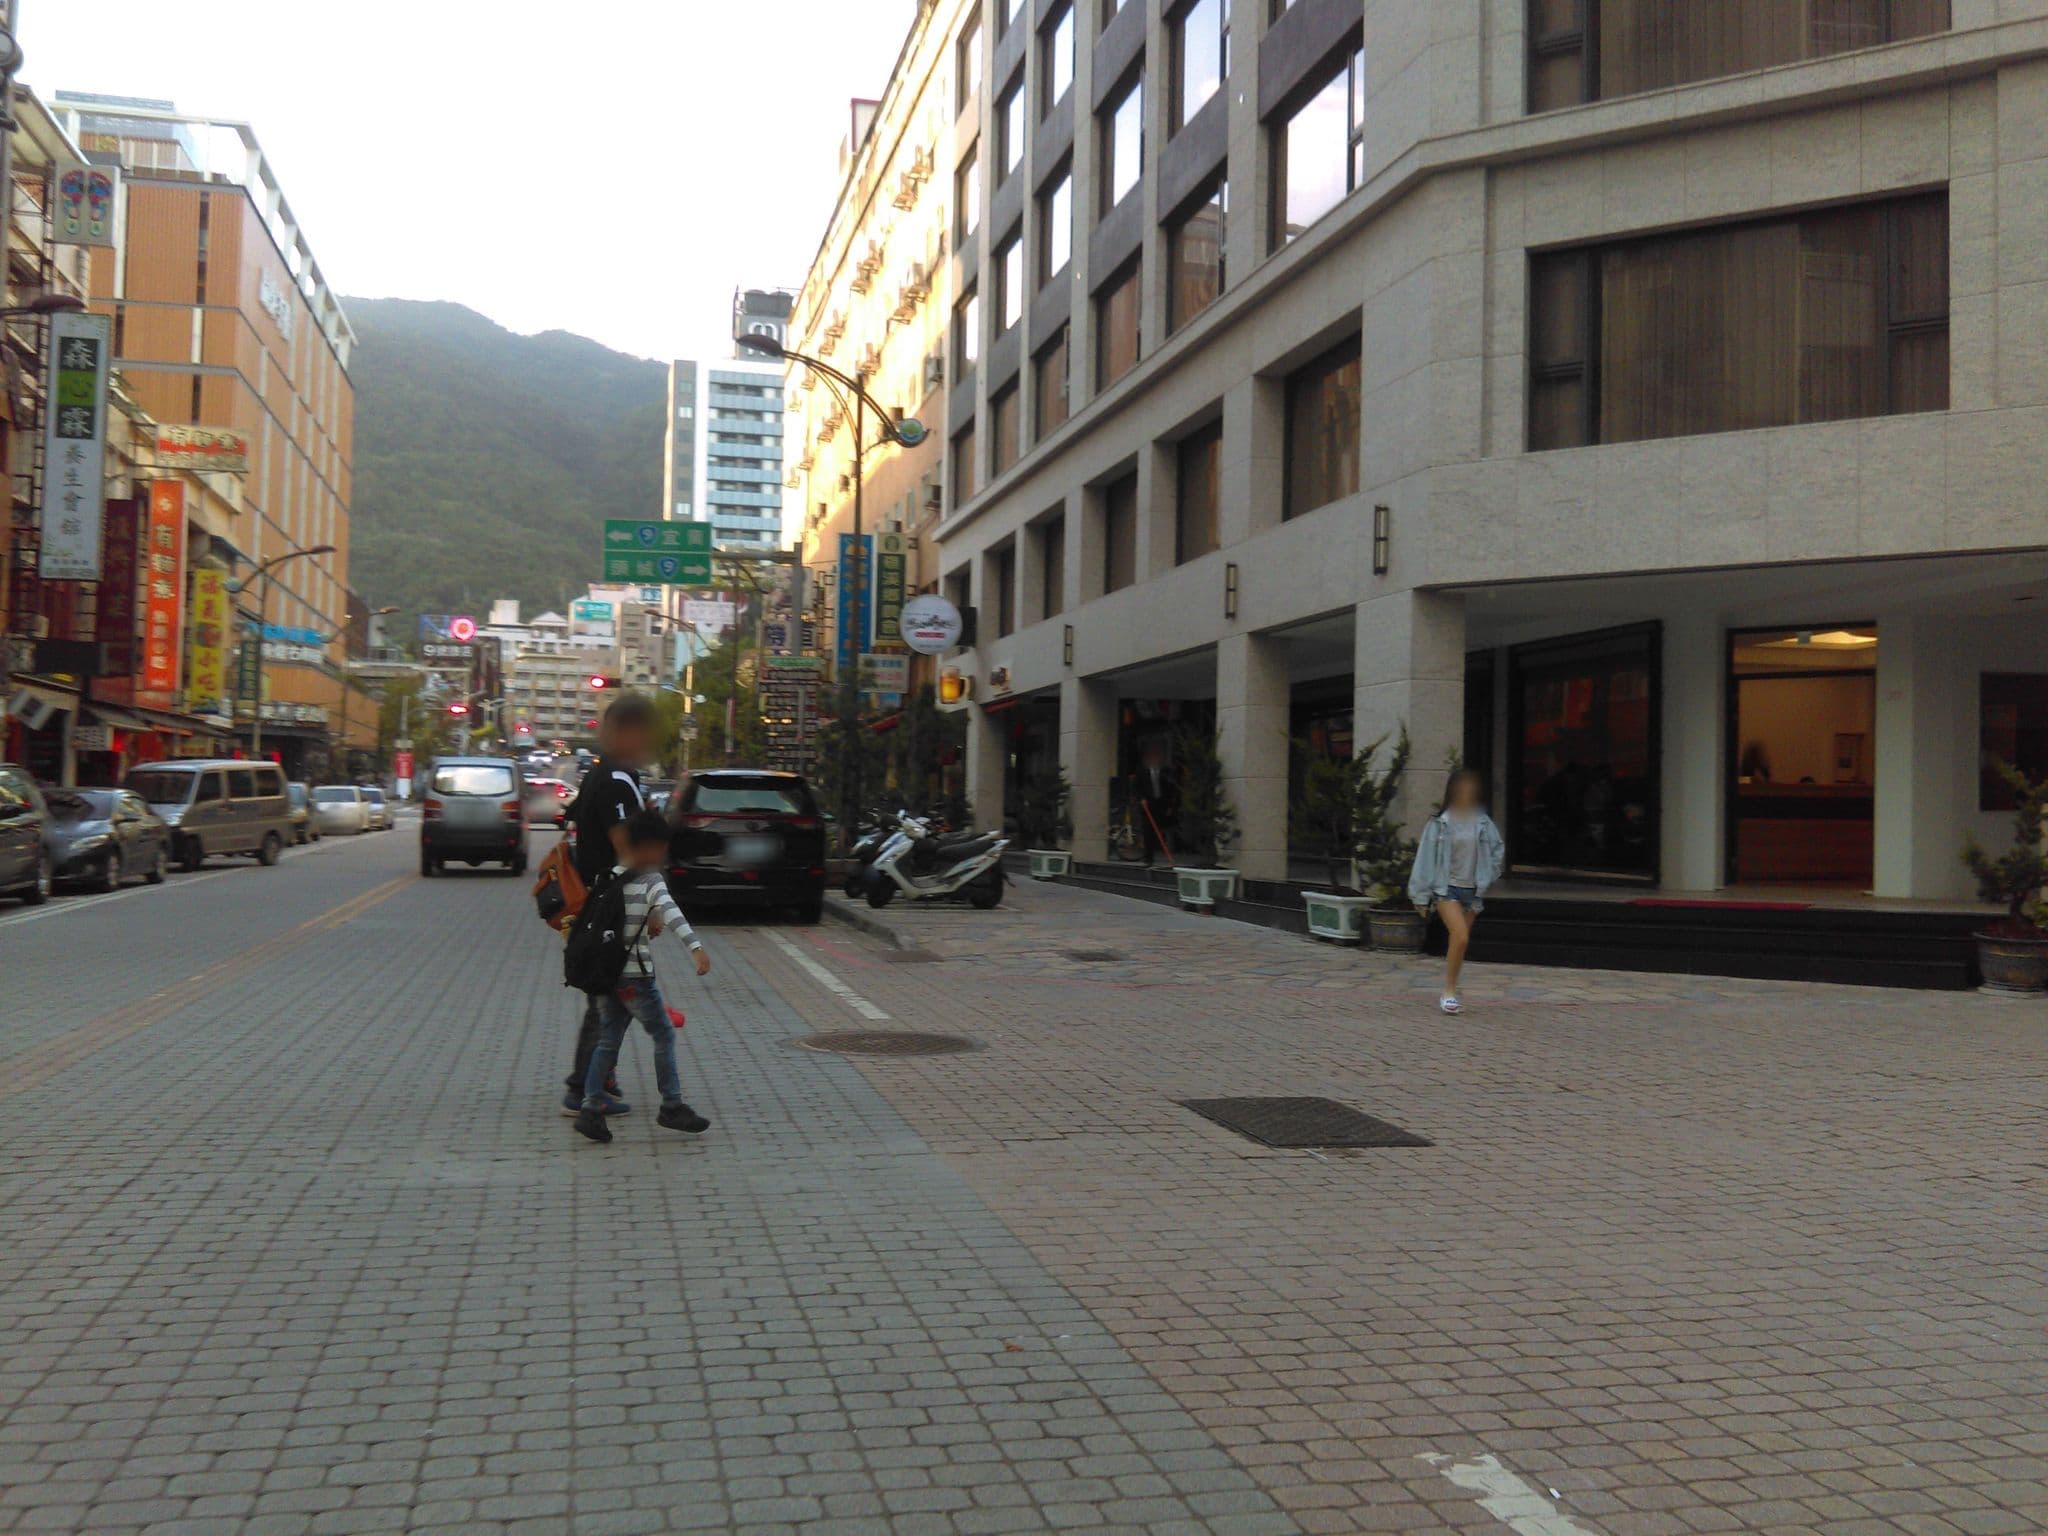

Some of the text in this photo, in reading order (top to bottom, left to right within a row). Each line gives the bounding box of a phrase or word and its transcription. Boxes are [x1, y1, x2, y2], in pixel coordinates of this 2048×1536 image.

[641, 529, 654, 541] 9
[663, 560, 674, 572] 9
[616, 803, 627, 820] 1
